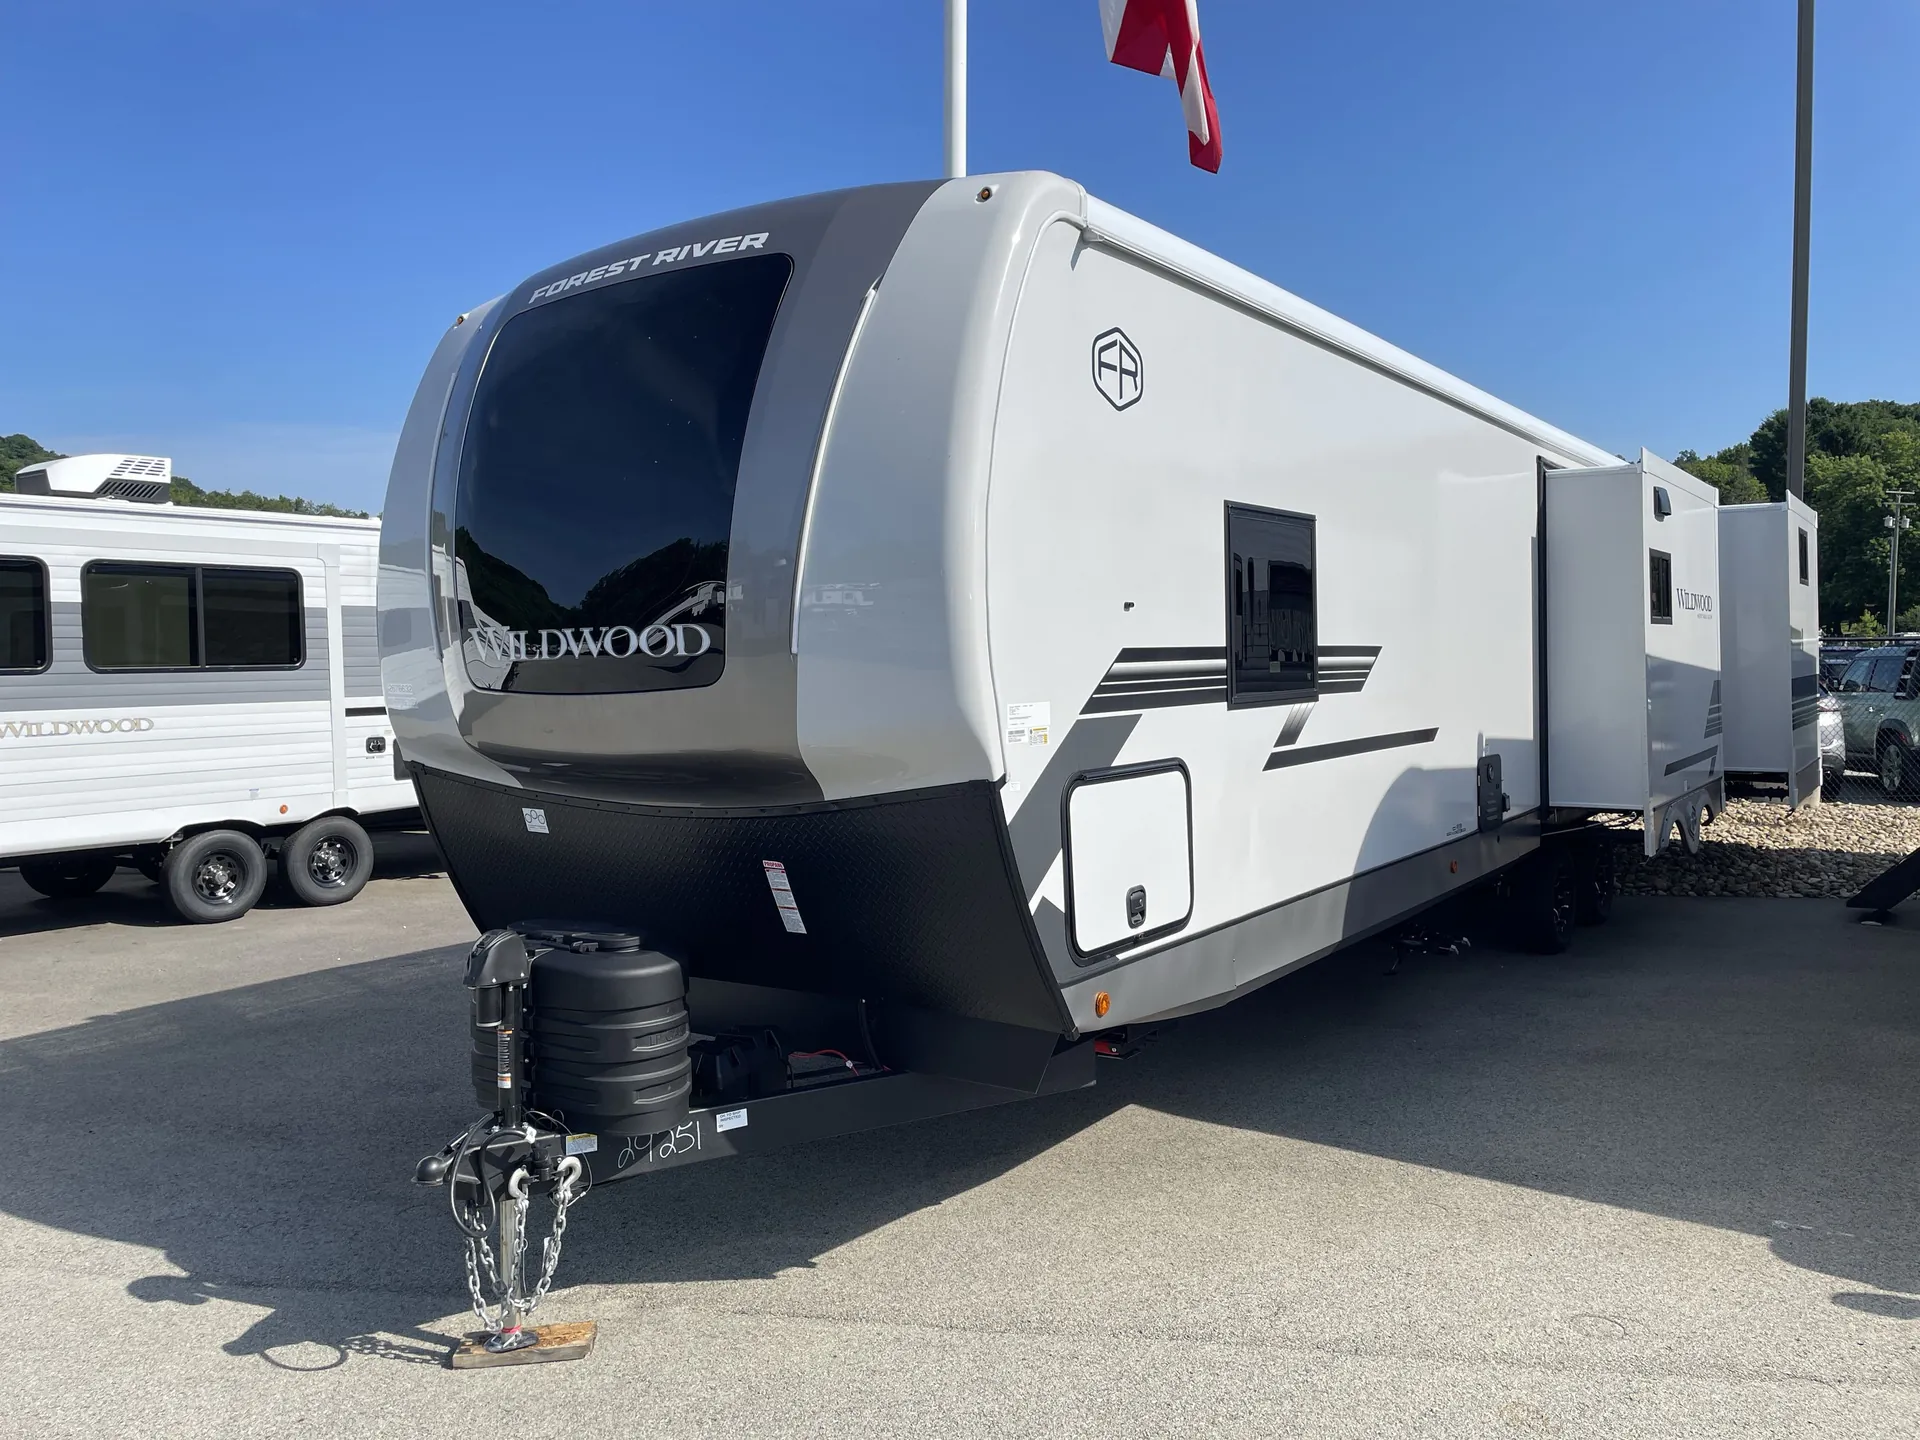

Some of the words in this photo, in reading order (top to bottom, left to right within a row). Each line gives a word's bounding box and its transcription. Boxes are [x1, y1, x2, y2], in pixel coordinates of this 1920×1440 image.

[528, 253, 651, 305] FOREST
[652, 232, 770, 266] RIVER
[1676, 588, 1712, 612] WILDWOOD
[468, 623, 711, 662] WILDWOOD
[0, 717, 155, 739] WILDWOOD
